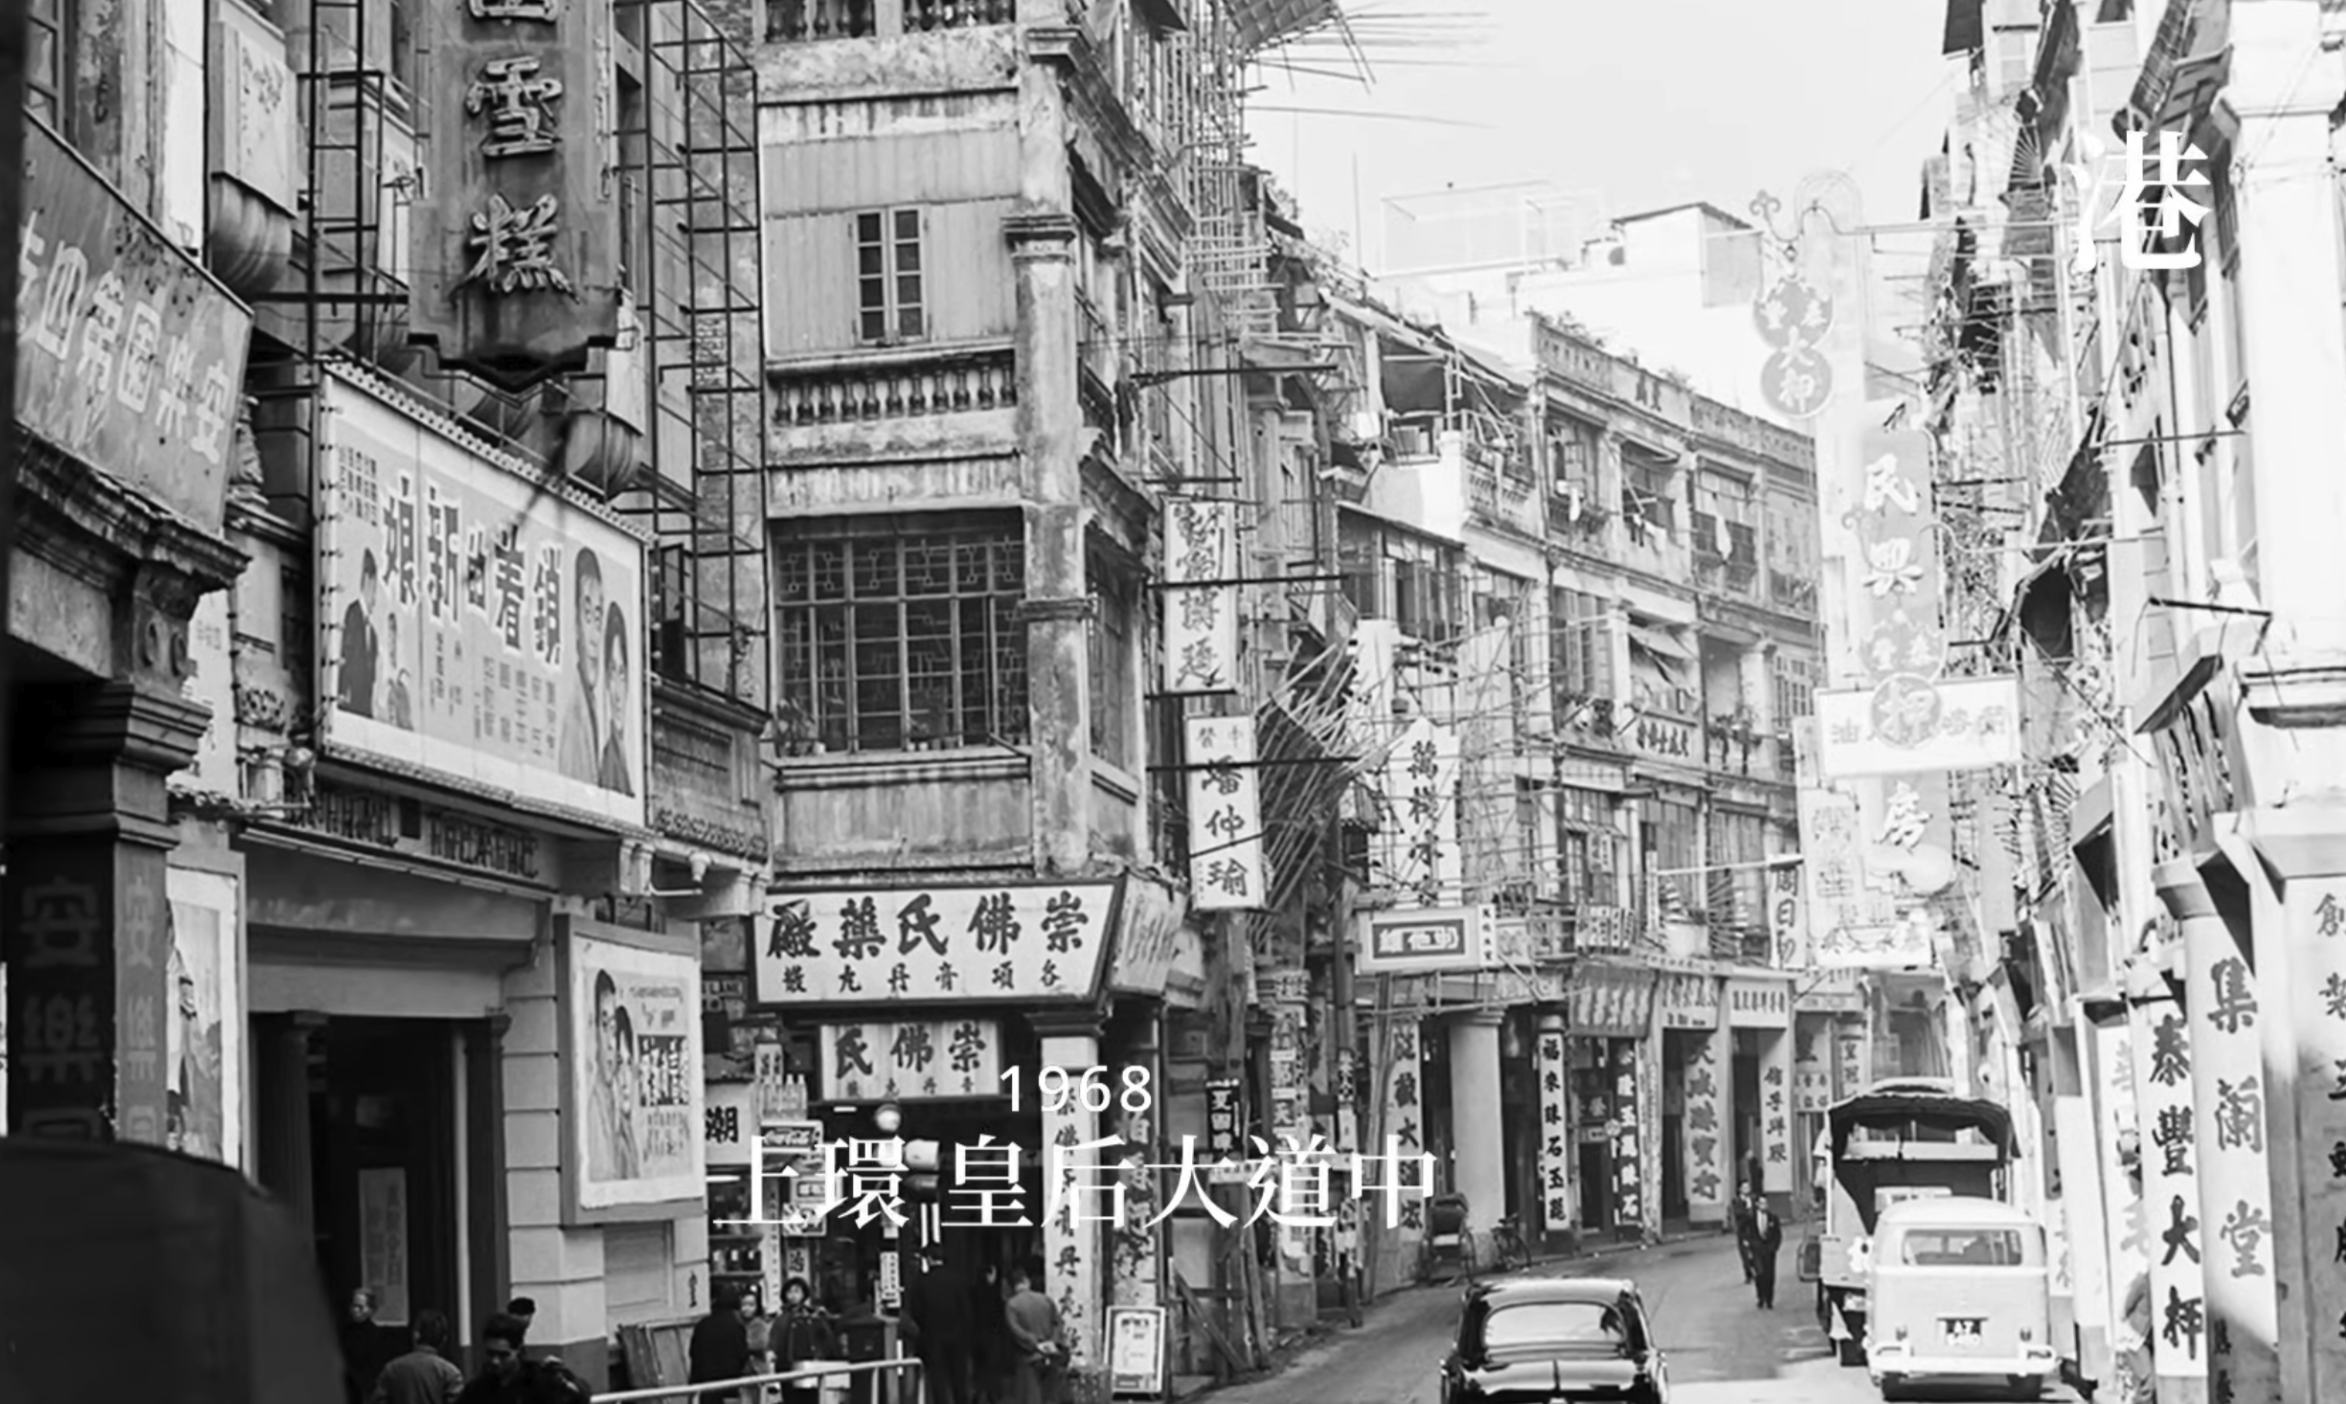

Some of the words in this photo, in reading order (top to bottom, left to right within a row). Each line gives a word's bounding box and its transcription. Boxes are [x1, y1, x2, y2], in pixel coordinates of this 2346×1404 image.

[464, 0, 580, 304] 雪糕
[766, 889, 1091, 962] 崇佛氏藥廠
[833, 1020, 989, 1080] 崇佛氏
[2149, 1012, 2204, 1361] 泰豐大押
[2207, 956, 2273, 1279] 集蘭堂
